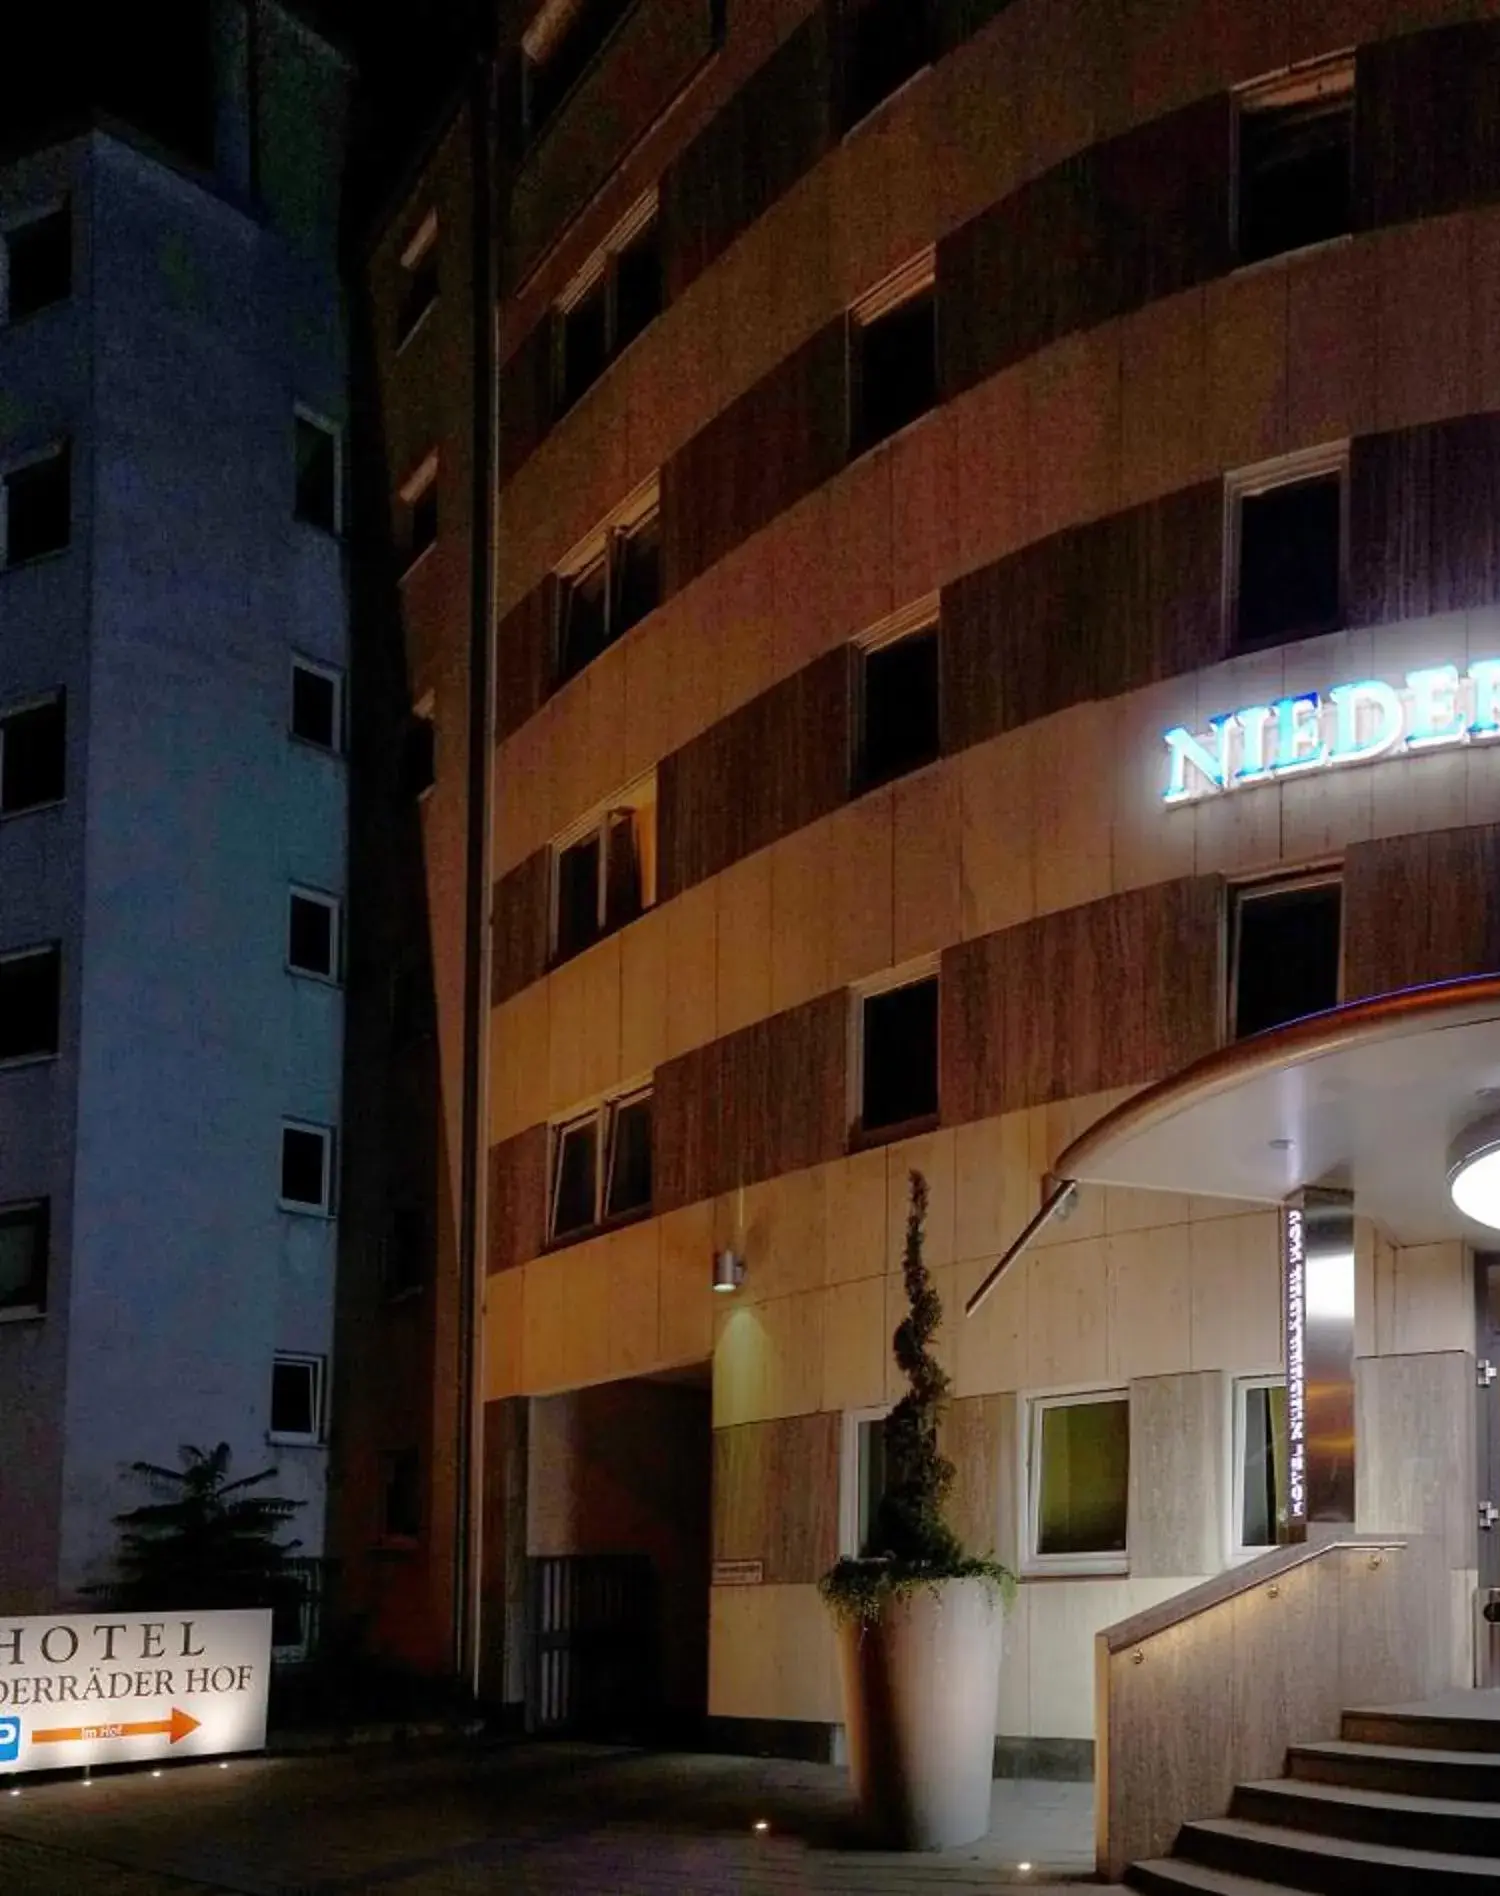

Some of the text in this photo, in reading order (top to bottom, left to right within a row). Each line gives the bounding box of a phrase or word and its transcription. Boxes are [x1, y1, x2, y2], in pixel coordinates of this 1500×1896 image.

[1290, 1443, 1303, 1516] HOTEL
[0, 1620, 206, 1666] HOTEL
[186, 1665, 254, 1693] HOF
